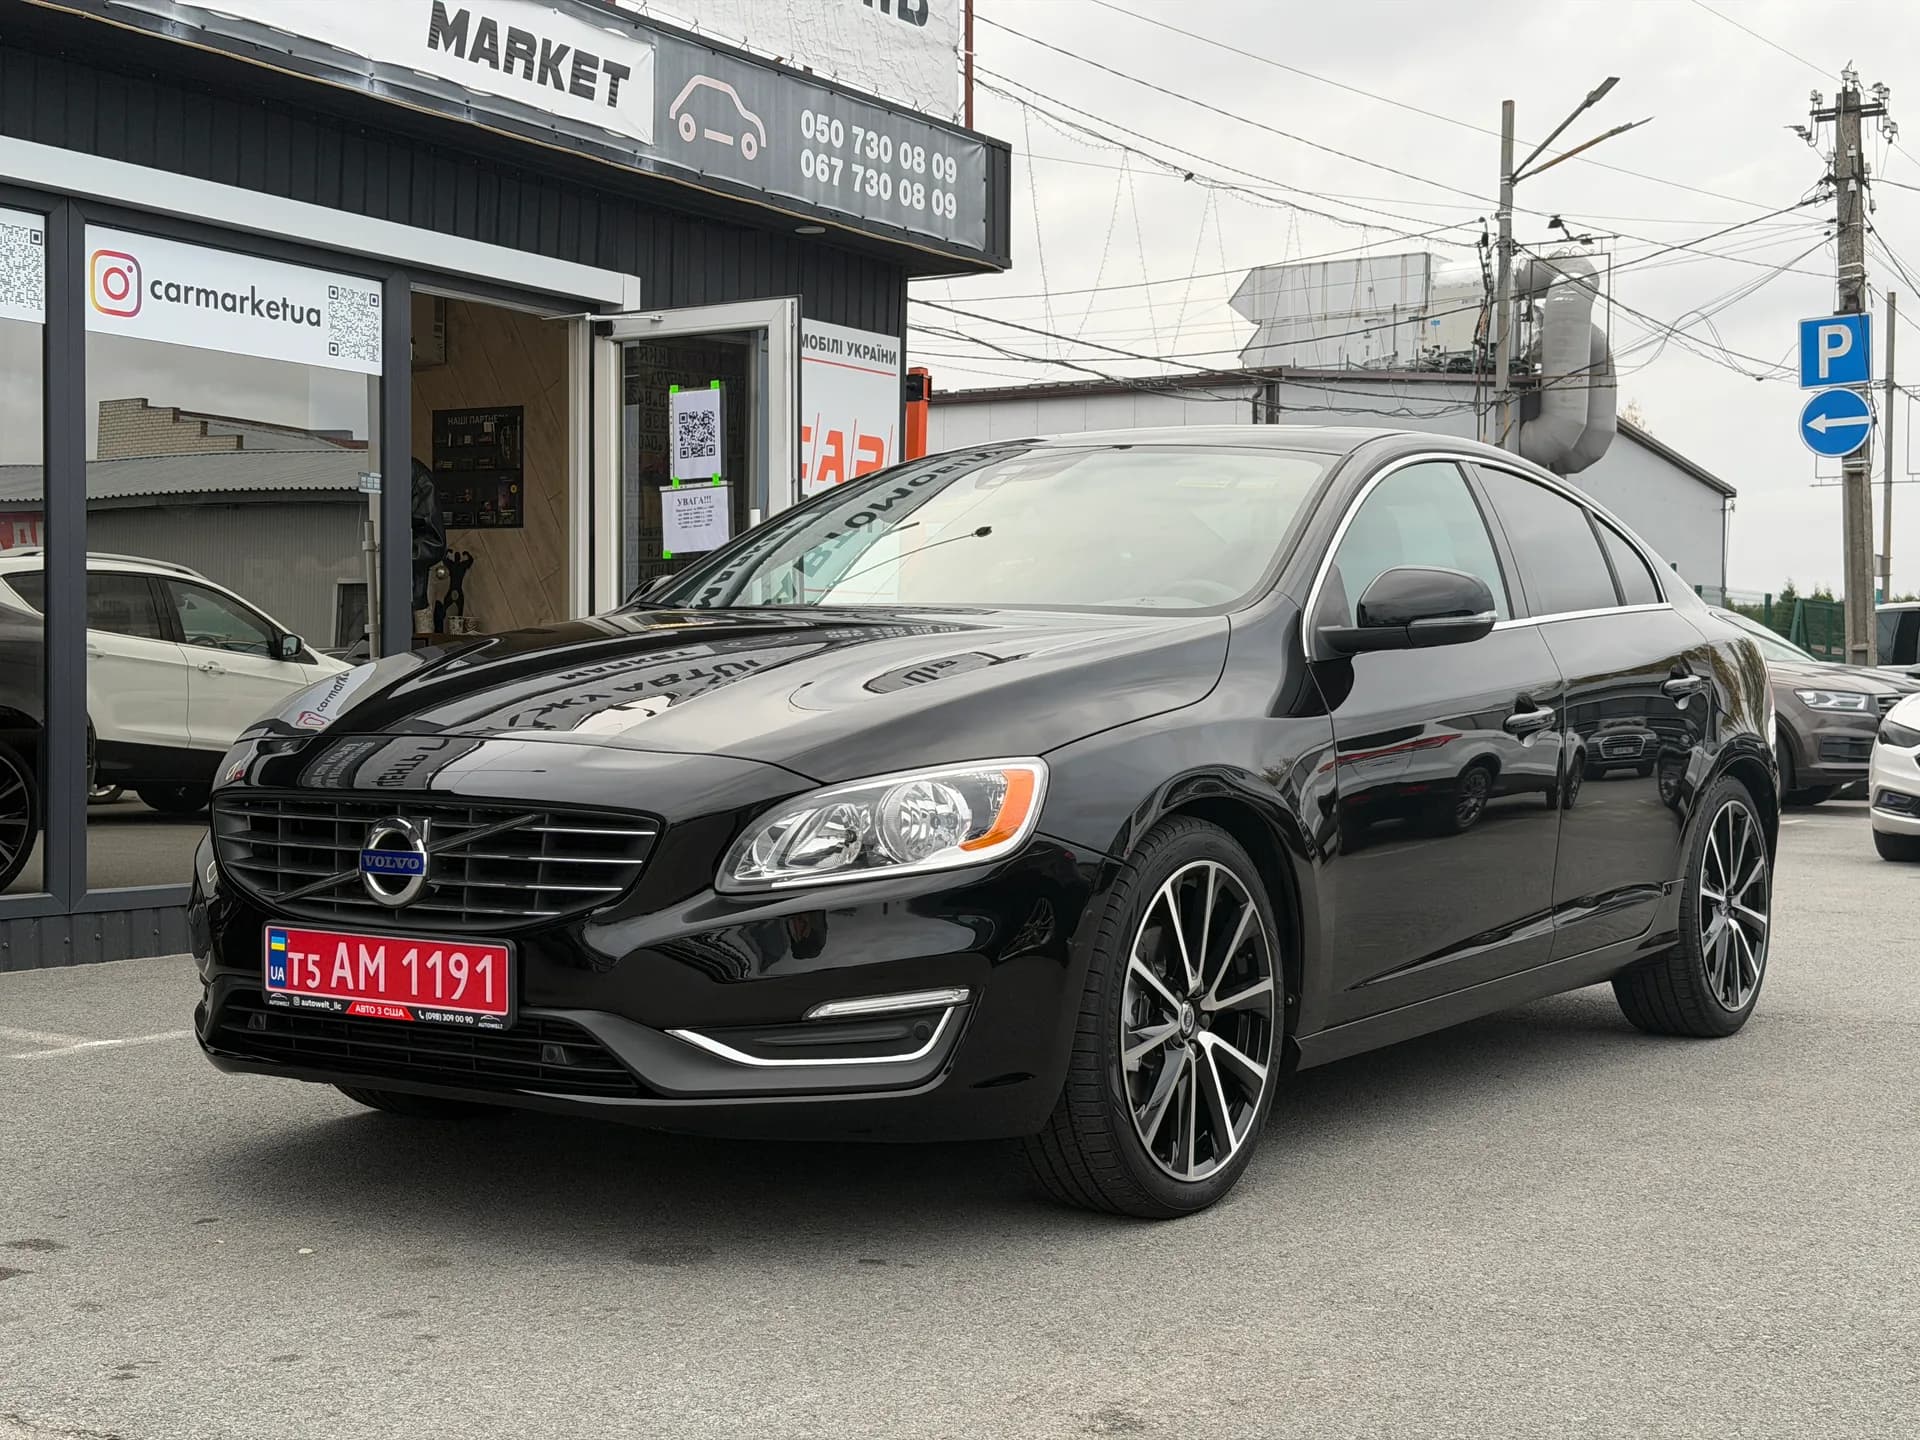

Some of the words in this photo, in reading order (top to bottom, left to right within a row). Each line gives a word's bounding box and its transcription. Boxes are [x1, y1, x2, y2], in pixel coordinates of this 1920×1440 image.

[427, 0, 631, 108] MARKET
[801, 109, 844, 148] 050
[851, 125, 892, 163] 730
[900, 142, 925, 174] 08
[932, 152, 957, 184] 09
[801, 149, 843, 186] 067
[851, 163, 892, 200] 730
[900, 178, 925, 210] 08
[932, 188, 957, 219] 09
[150, 279, 321, 327] carmarketua
[847, 341, 897, 365] УКРАЇНИ
[1818, 324, 1853, 379] P
[677, 495, 712, 506] УВАГА!!!
[363, 855, 420, 869] VOLVO
[270, 966, 285, 981] UA
[288, 951, 320, 988] T5
[330, 942, 386, 992] AM
[402, 948, 493, 1003] 1191
[355, 1004, 376, 1014] АВТО
[383, 1008, 405, 1017] США
[442, 1013, 454, 1022] 309
[455, 1015, 463, 1023] 00
[465, 1015, 474, 1024] 90
